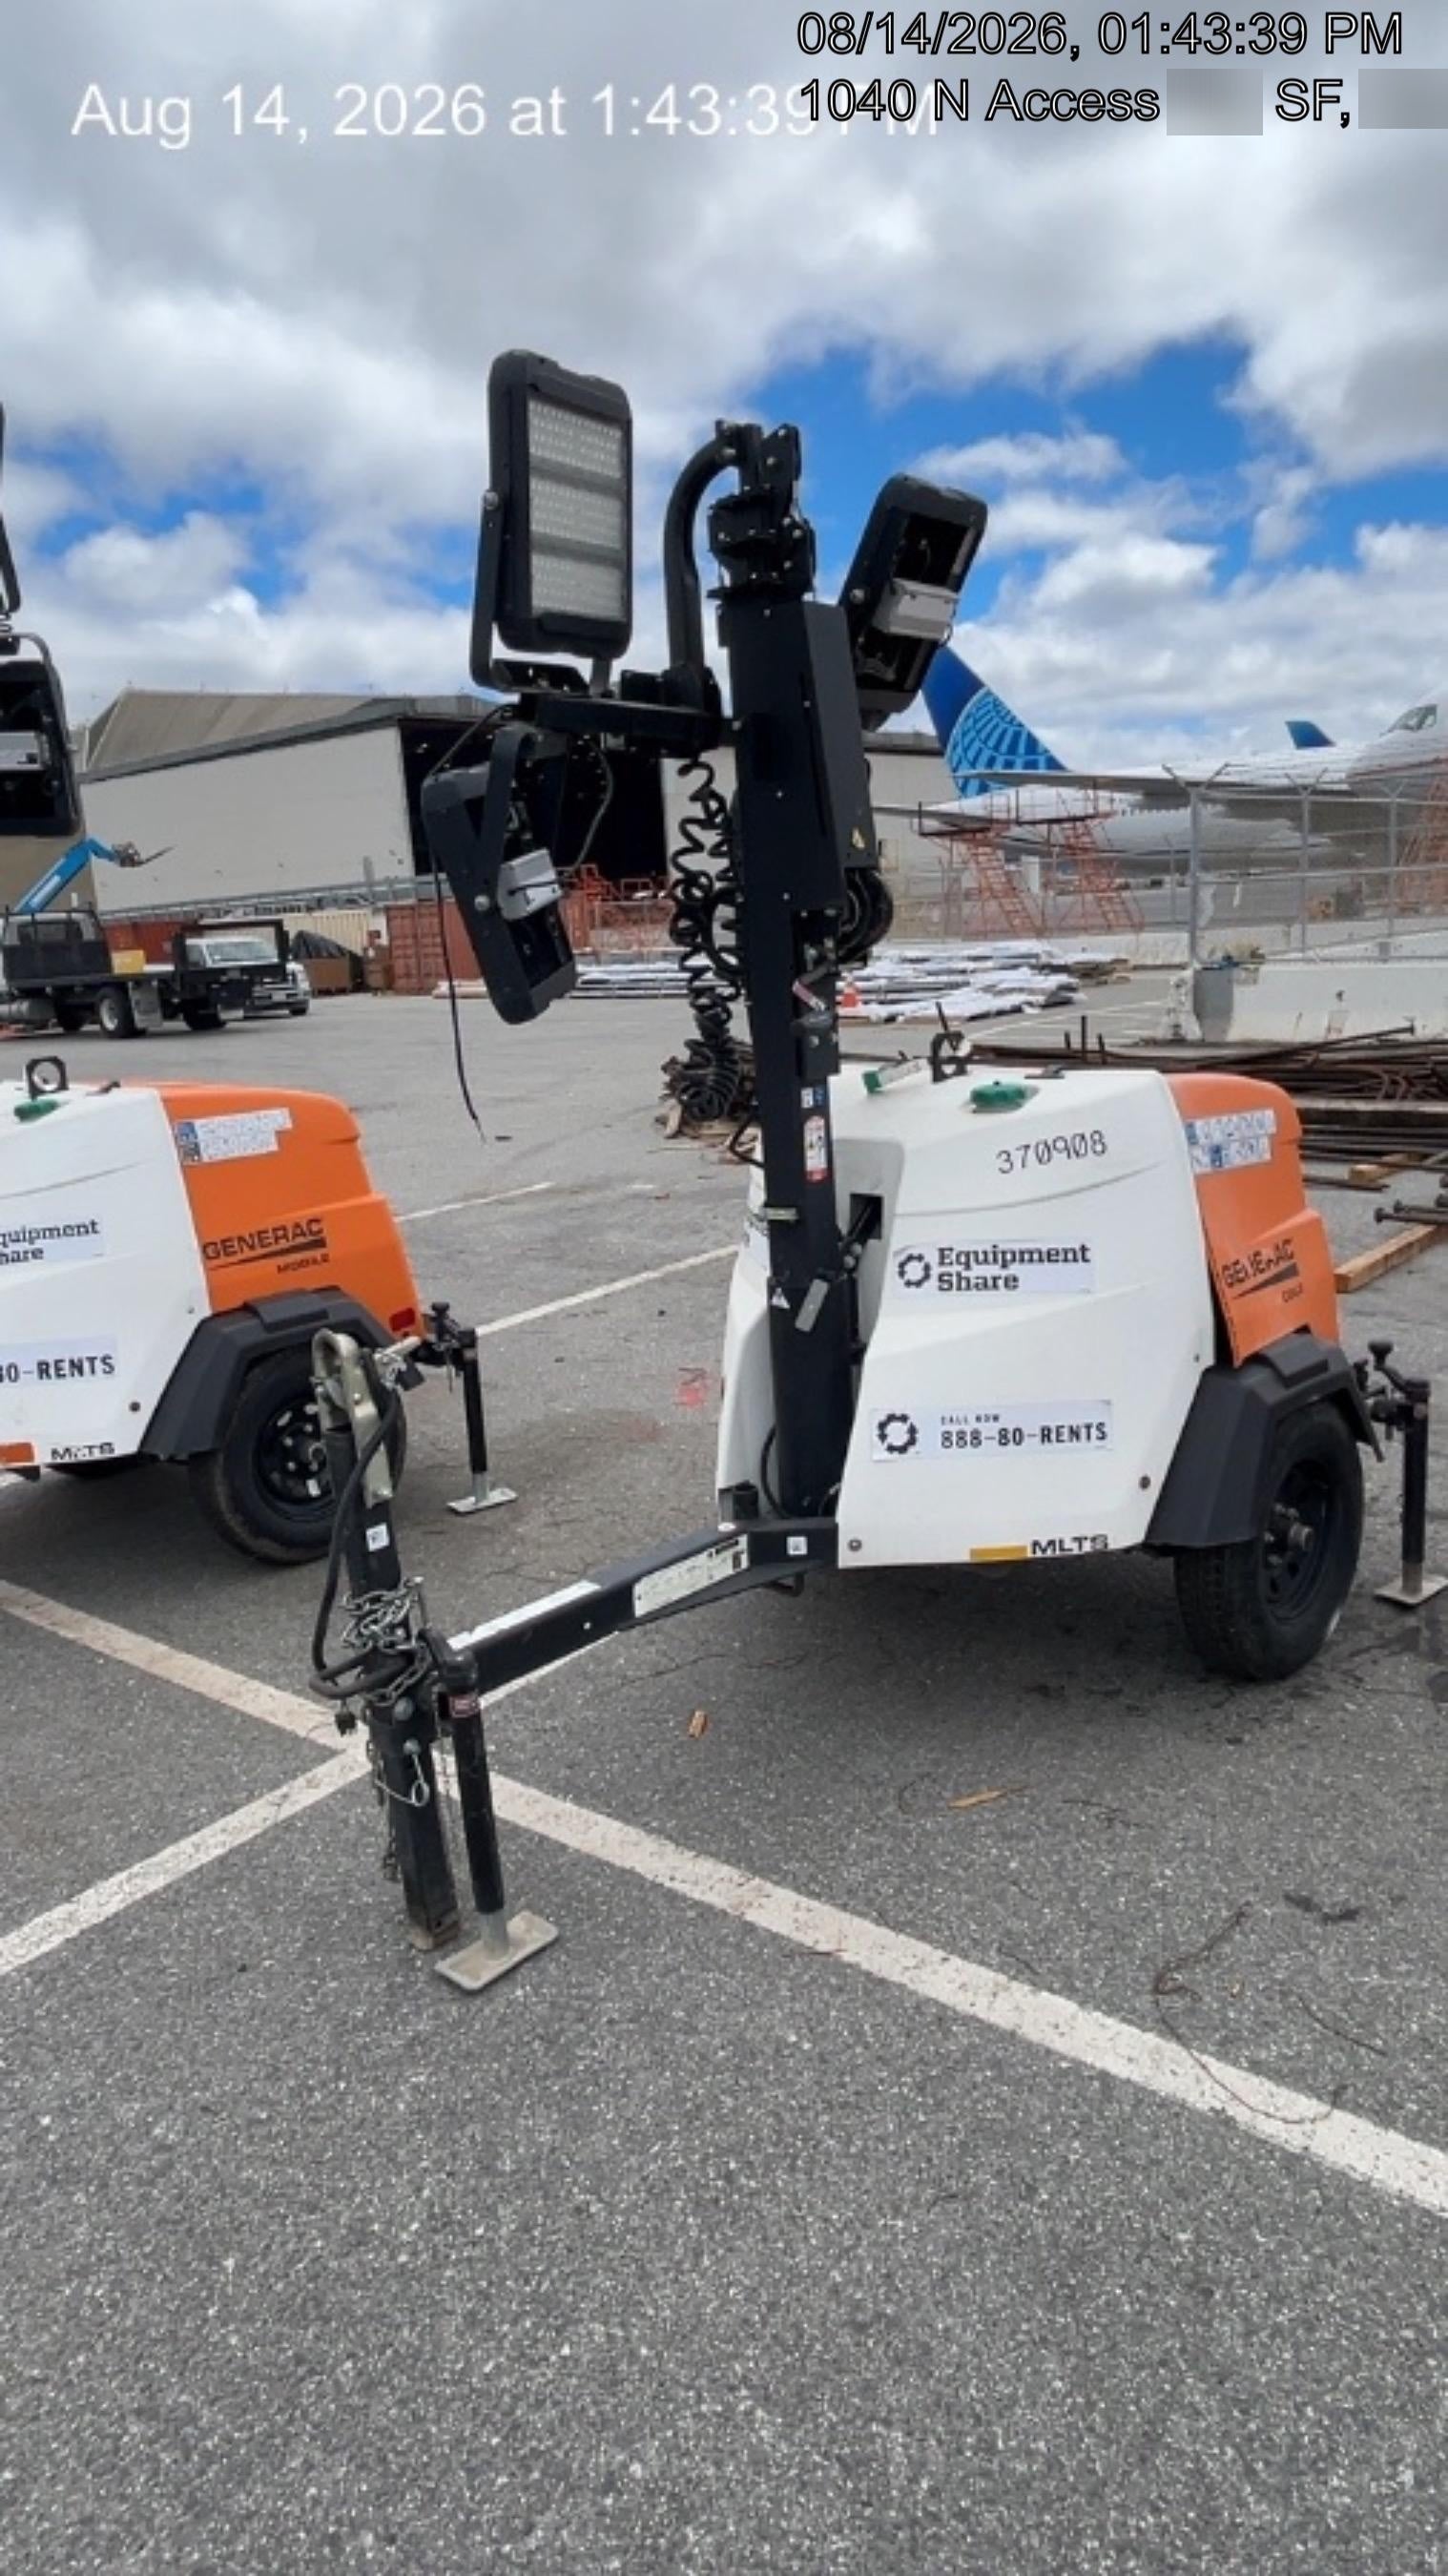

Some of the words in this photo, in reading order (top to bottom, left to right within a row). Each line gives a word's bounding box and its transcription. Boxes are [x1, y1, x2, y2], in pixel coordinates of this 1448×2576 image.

[997, 1130, 1108, 1174] 370908
[203, 1219, 324, 1259] GENERAC
[938, 1244, 1091, 1271] Equipment
[938, 1271, 1020, 1292] Share
[941, 1422, 1107, 1449] 888-80-RENTS
